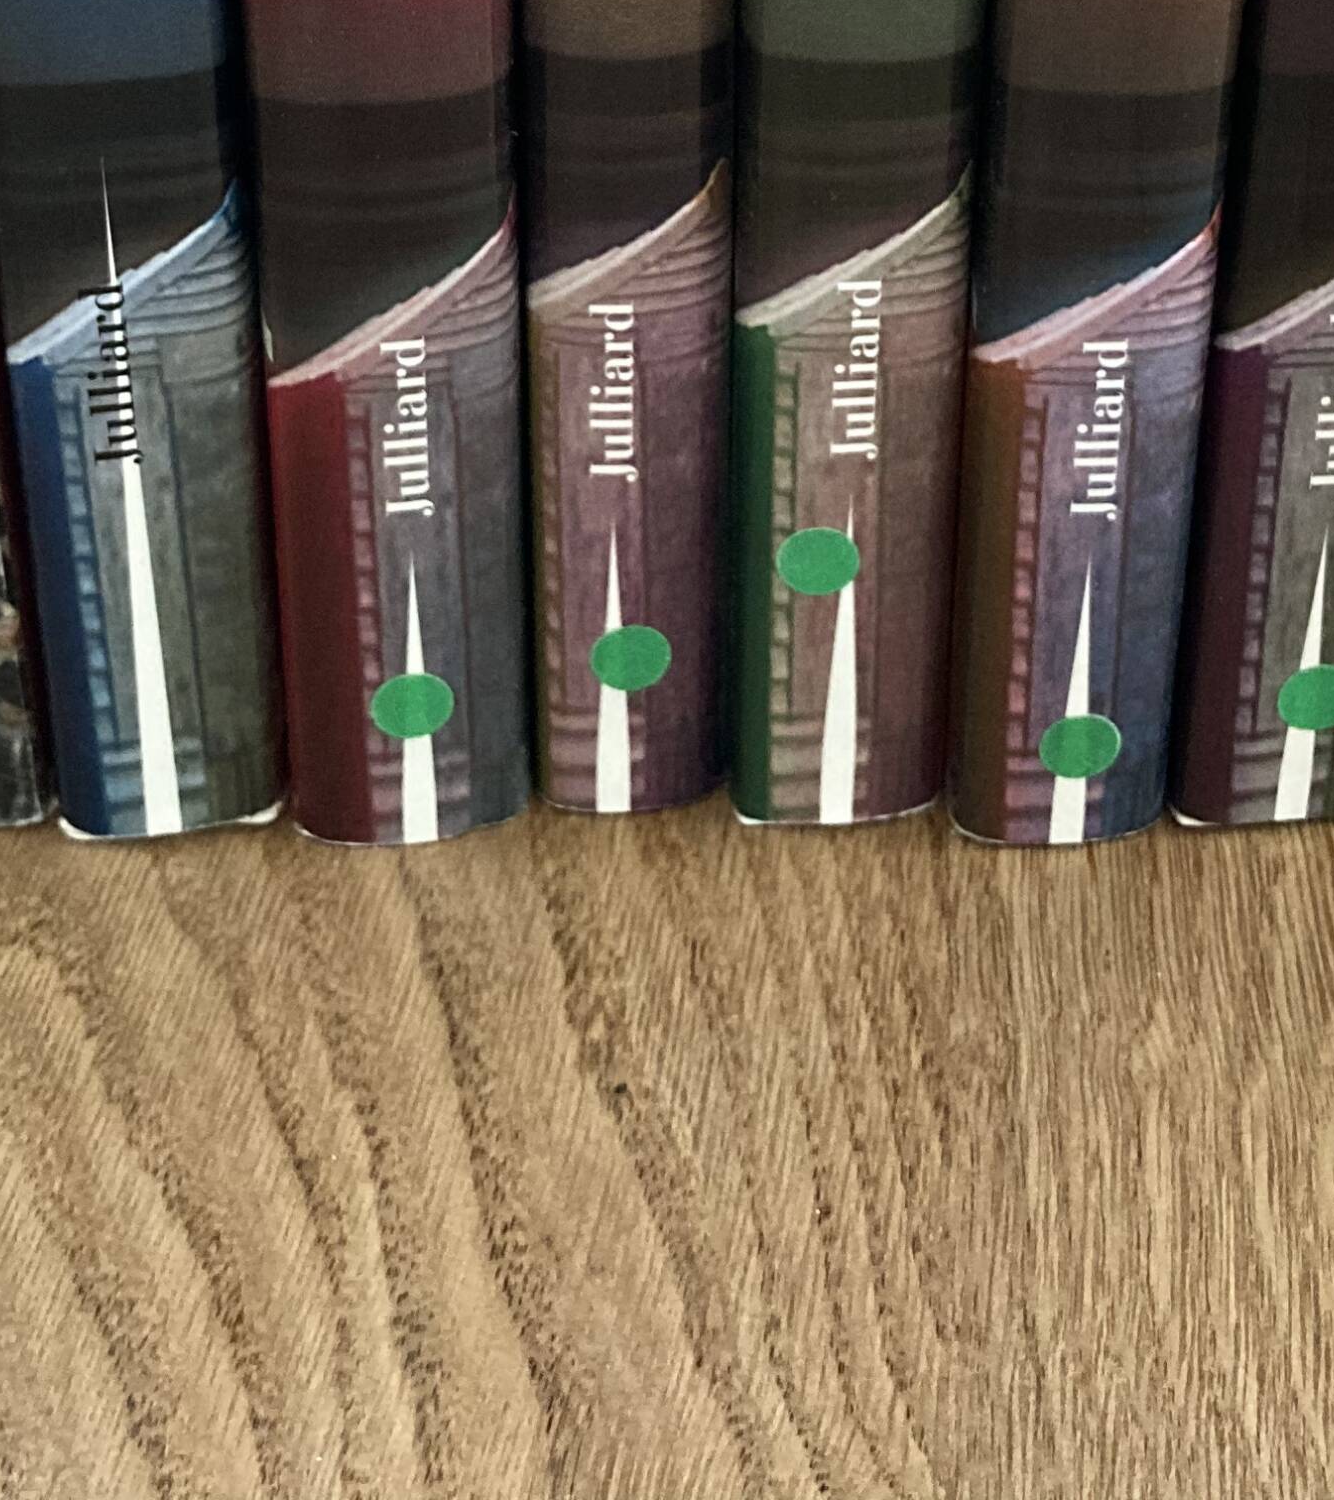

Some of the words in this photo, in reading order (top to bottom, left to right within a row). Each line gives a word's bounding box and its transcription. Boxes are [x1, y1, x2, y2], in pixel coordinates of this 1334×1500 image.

[78, 283, 144, 466] Julliard
[379, 338, 434, 516] Julliard
[588, 303, 637, 483] Julliard
[830, 280, 882, 460] Julliard
[1070, 338, 1129, 521] Julliard
